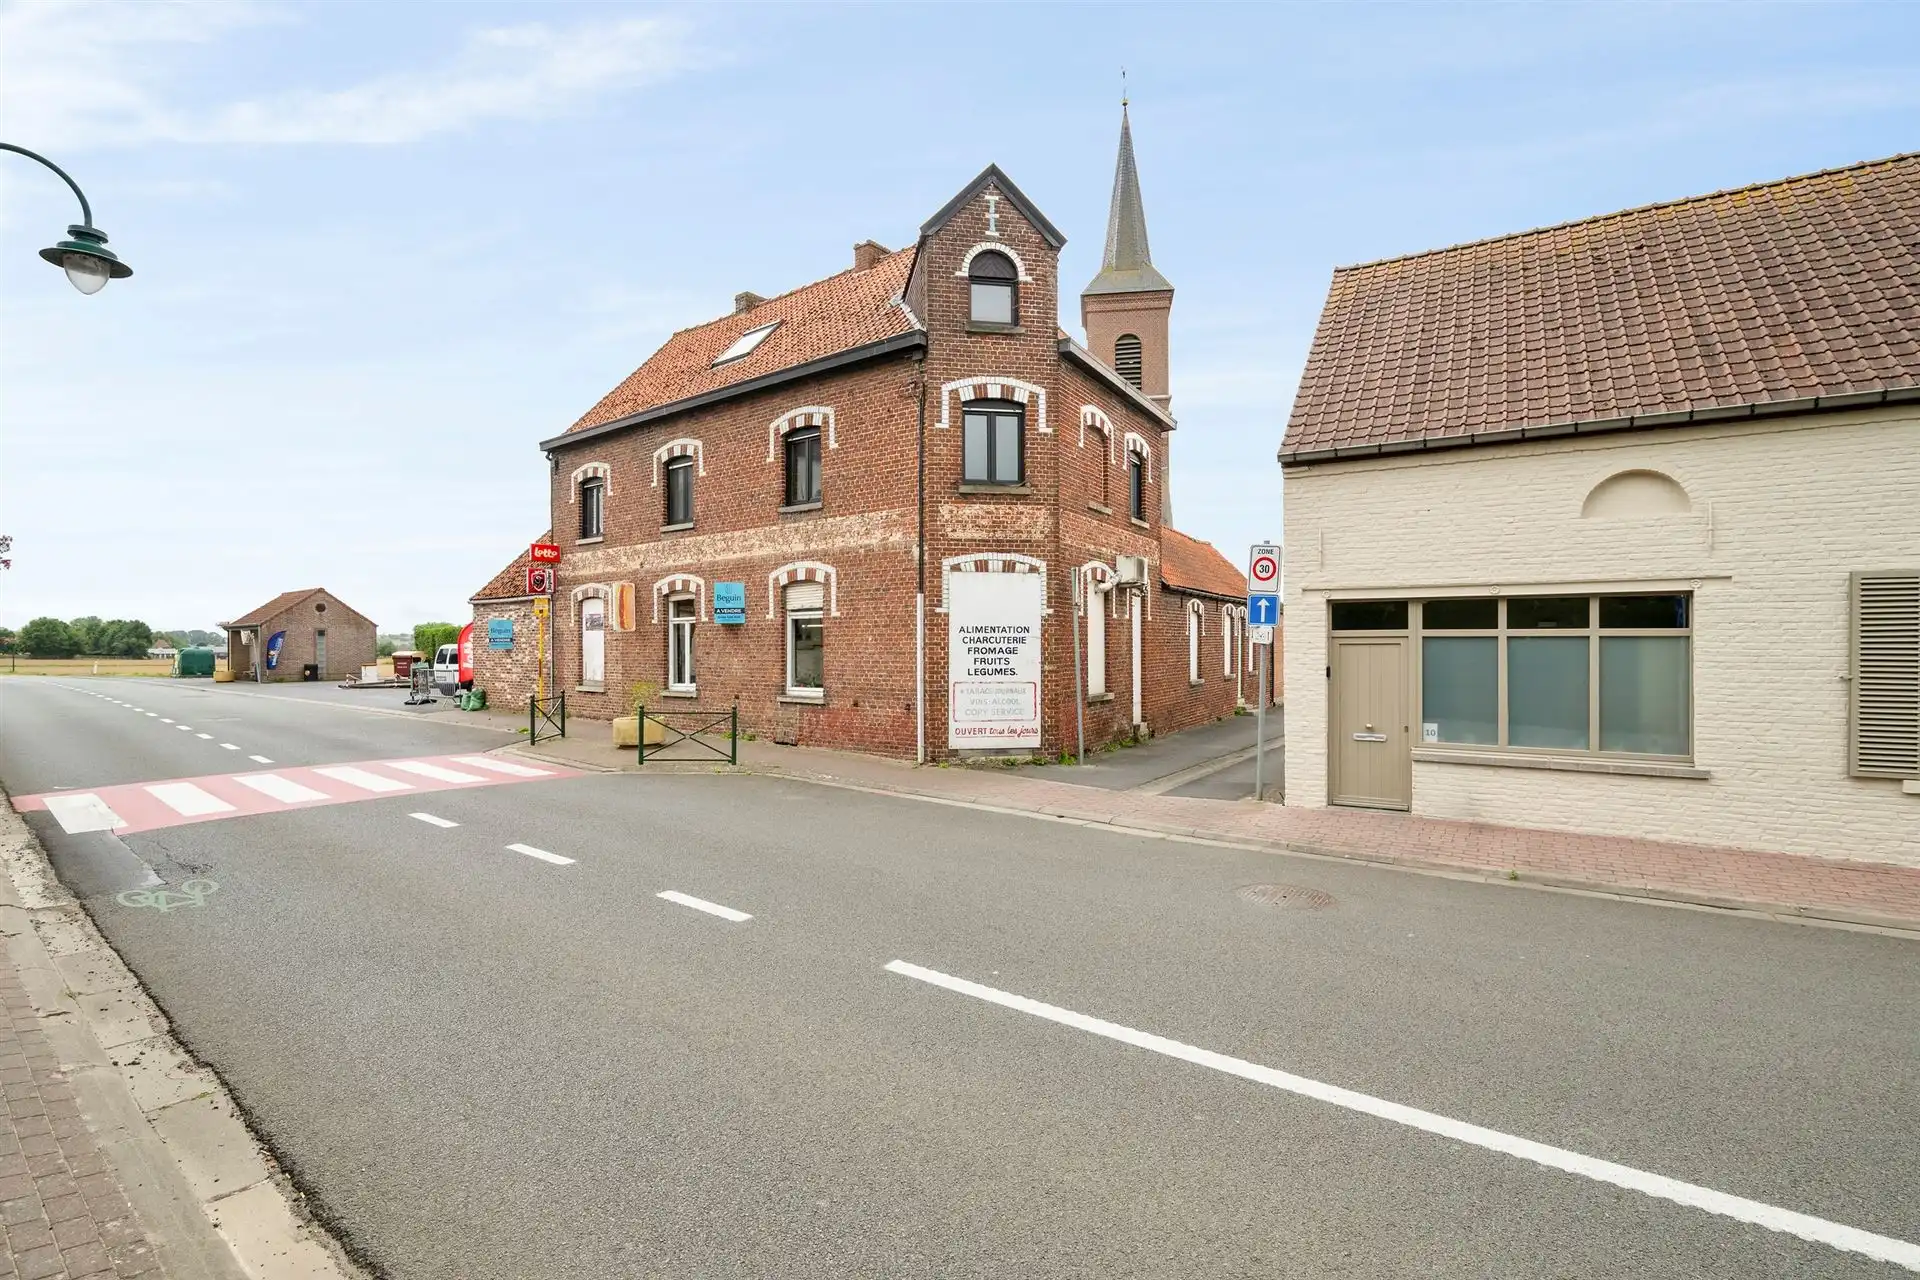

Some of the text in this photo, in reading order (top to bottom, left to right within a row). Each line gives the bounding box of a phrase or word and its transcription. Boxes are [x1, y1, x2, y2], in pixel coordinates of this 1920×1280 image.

[534, 547, 558, 558] lotto
[1259, 564, 1270, 574] 30
[716, 593, 742, 604] Beguin
[958, 625, 1030, 634] ALIMENTATION
[962, 636, 1027, 645] CHARCUTERIE
[967, 646, 1019, 655] FROMAGE
[973, 657, 1011, 666] FRUITS
[967, 667, 1019, 676] LEGUMES.
[965, 708, 1025, 716] COPY SERVICE
[955, 727, 987, 736] OUVERT
[1017, 725, 1039, 738] jours
[1425, 729, 1436, 737] 10
